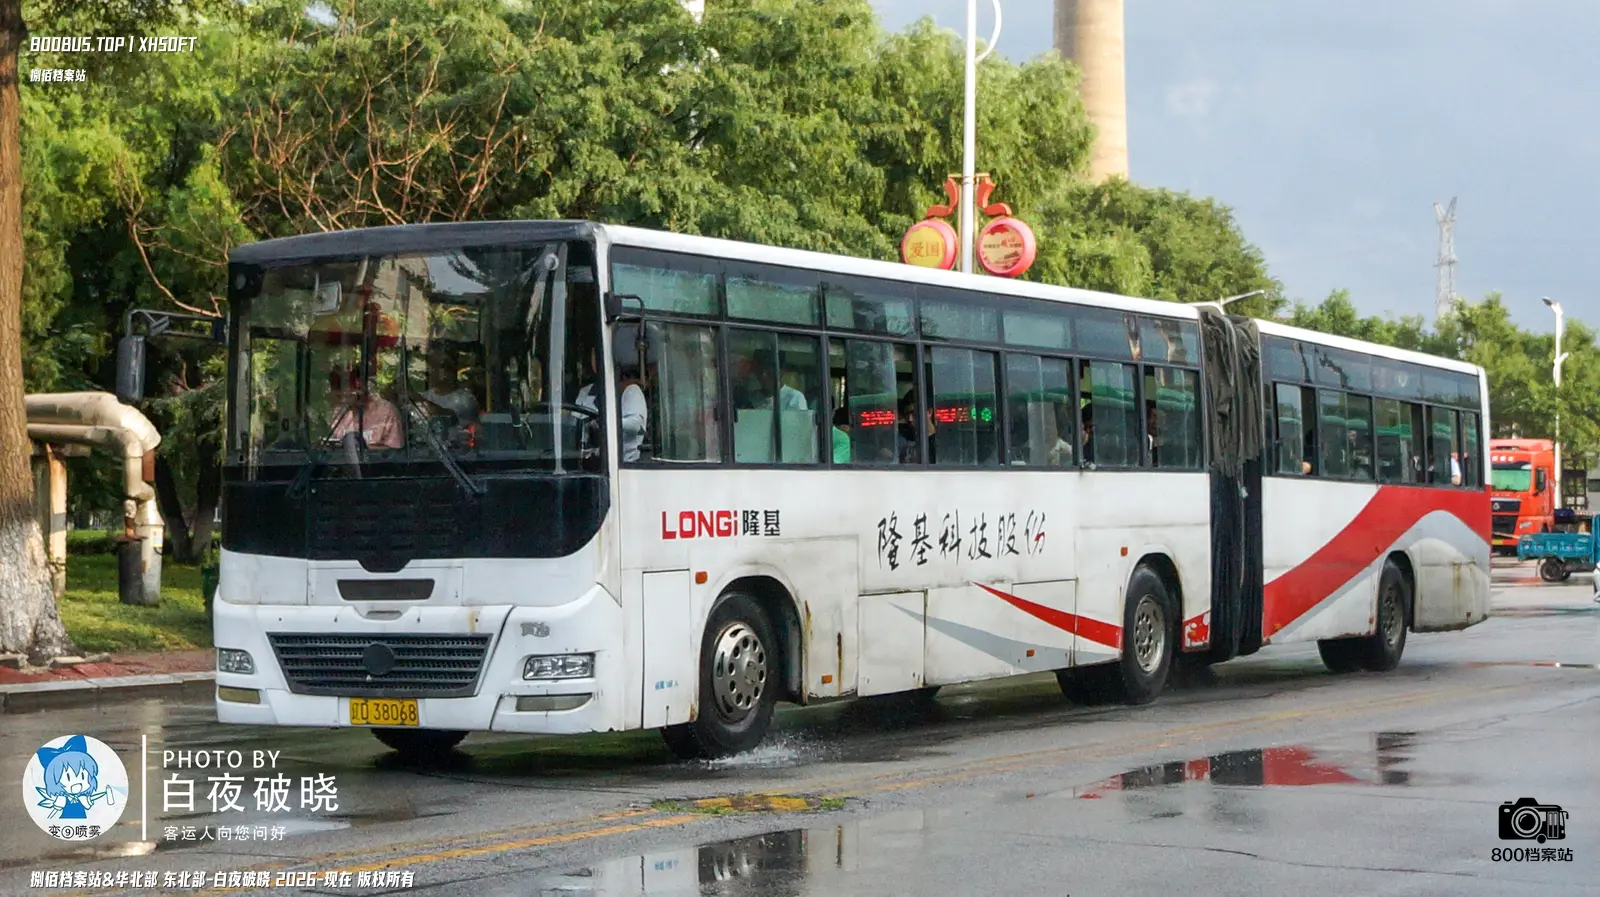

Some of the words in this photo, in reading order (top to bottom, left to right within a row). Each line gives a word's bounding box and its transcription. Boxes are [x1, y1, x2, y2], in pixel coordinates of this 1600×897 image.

[910, 241, 939, 258] 爱国
[742, 509, 781, 536] 隆基
[877, 508, 1047, 571] 隆基科技股份
